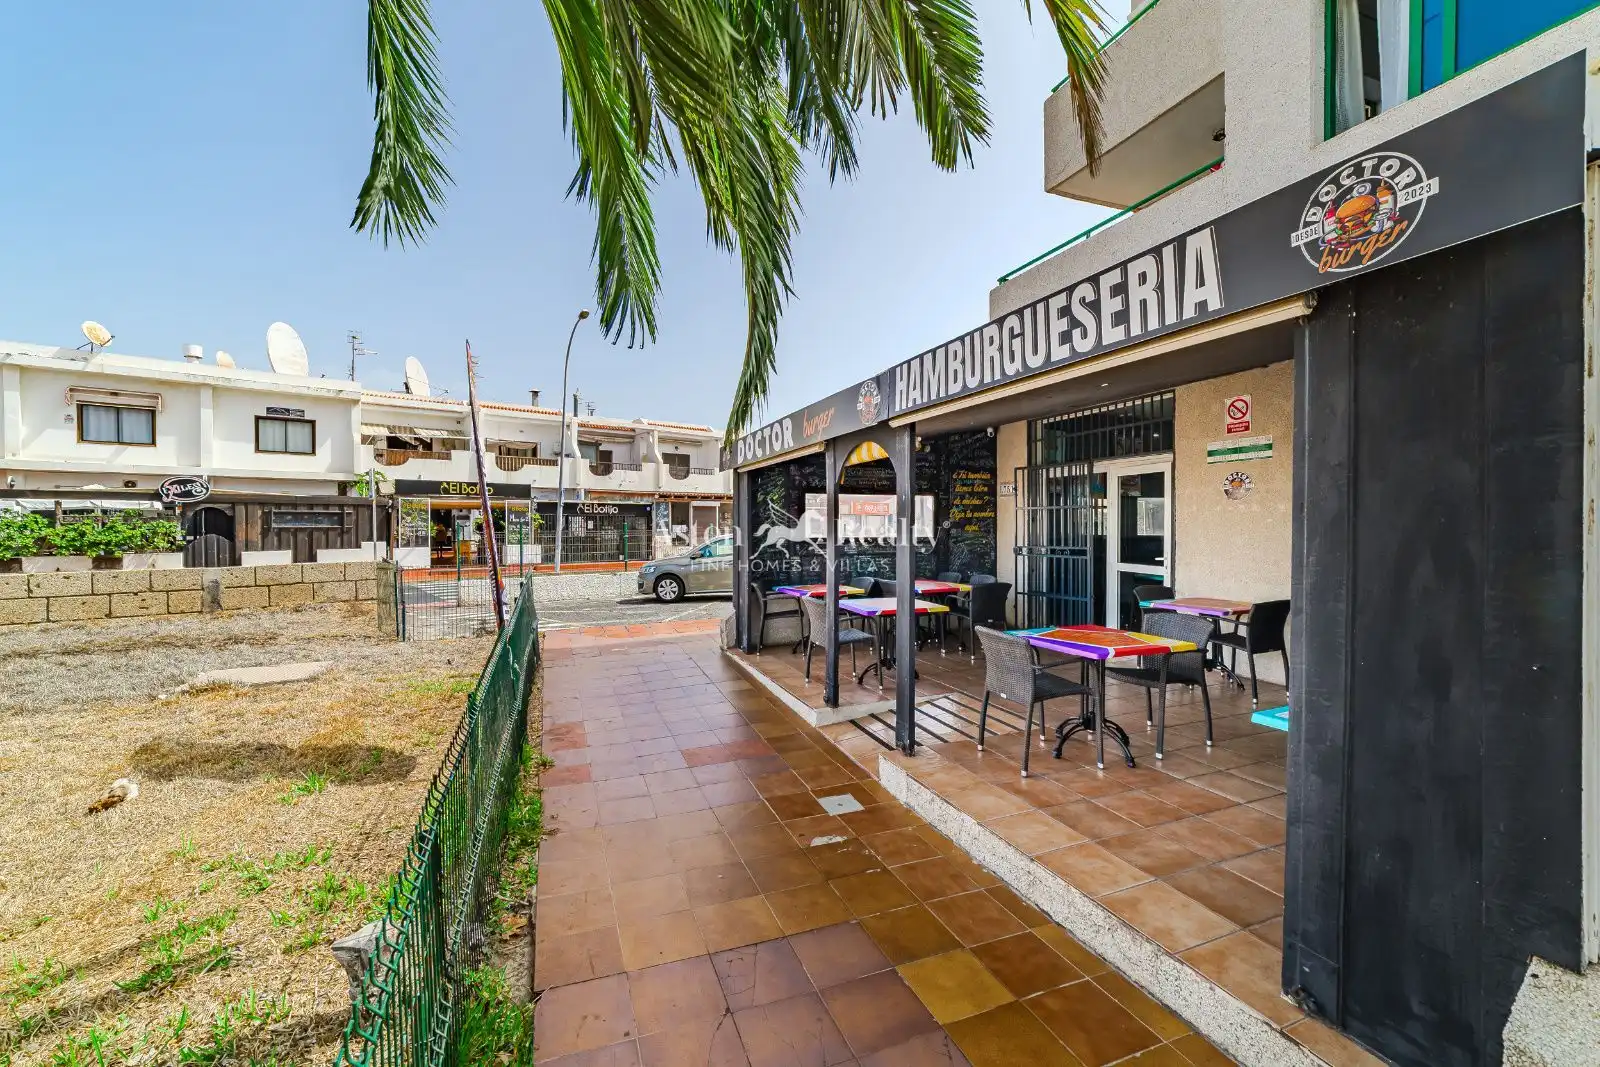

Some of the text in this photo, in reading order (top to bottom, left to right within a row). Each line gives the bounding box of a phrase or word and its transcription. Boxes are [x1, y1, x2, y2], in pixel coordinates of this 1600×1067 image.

[1305, 158, 1417, 222] DOCTOR
[1403, 182, 1432, 202] 2023
[1294, 225, 1318, 243] DESDE
[1318, 220, 1409, 273] burger
[894, 226, 1225, 412] HAMBURGUESERIA
[737, 406, 835, 465] DOCTOR burger
[449, 482, 493, 495] El Boto
[584, 503, 619, 515] El Botijo
